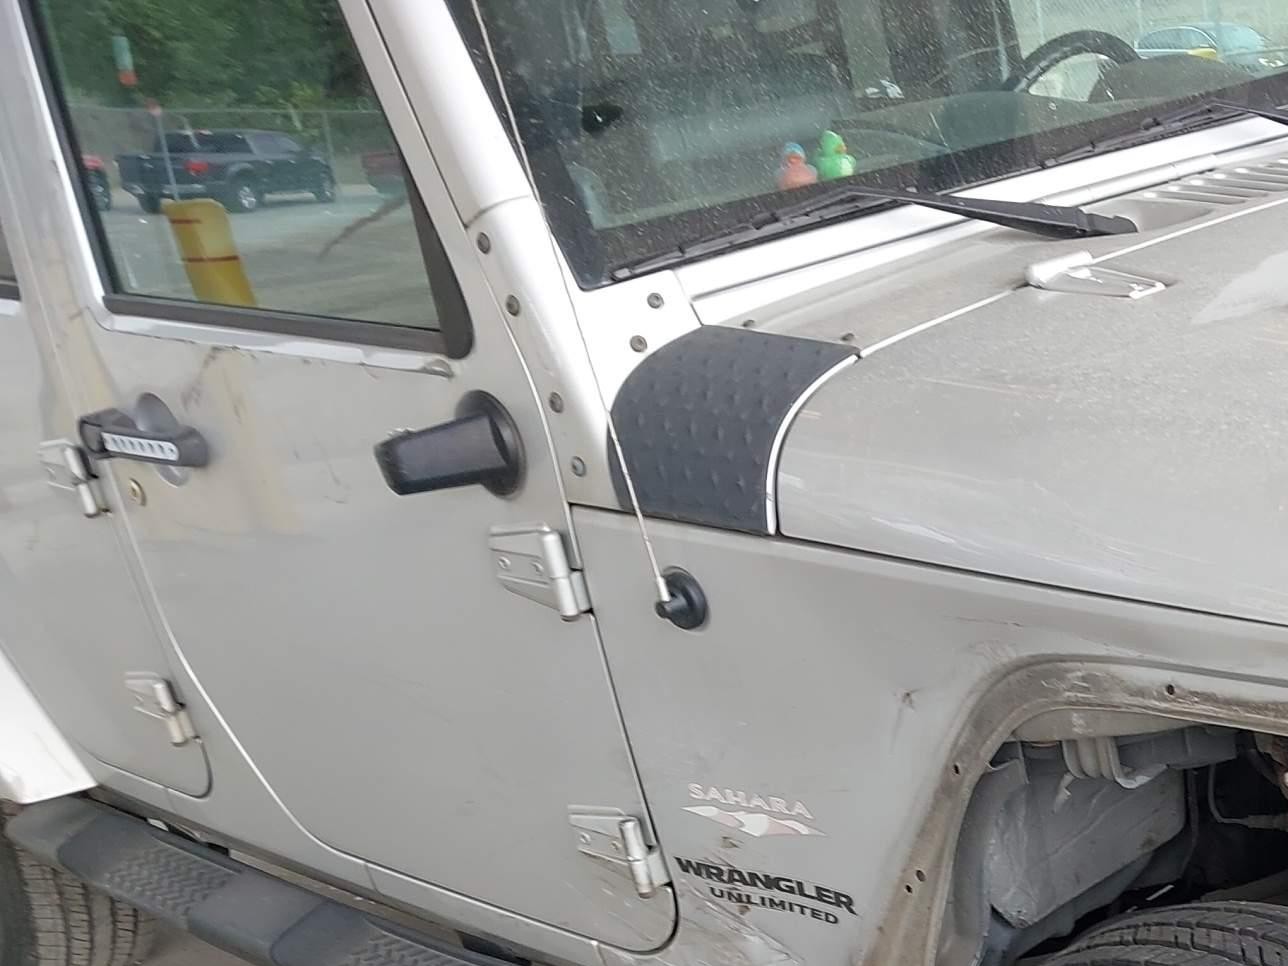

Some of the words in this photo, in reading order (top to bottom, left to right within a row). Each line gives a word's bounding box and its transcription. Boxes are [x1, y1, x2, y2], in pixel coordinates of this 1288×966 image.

[687, 783, 815, 820] SAHARA
[673, 856, 858, 916] WRANGLER
[708, 887, 840, 925] UNLIMITED
